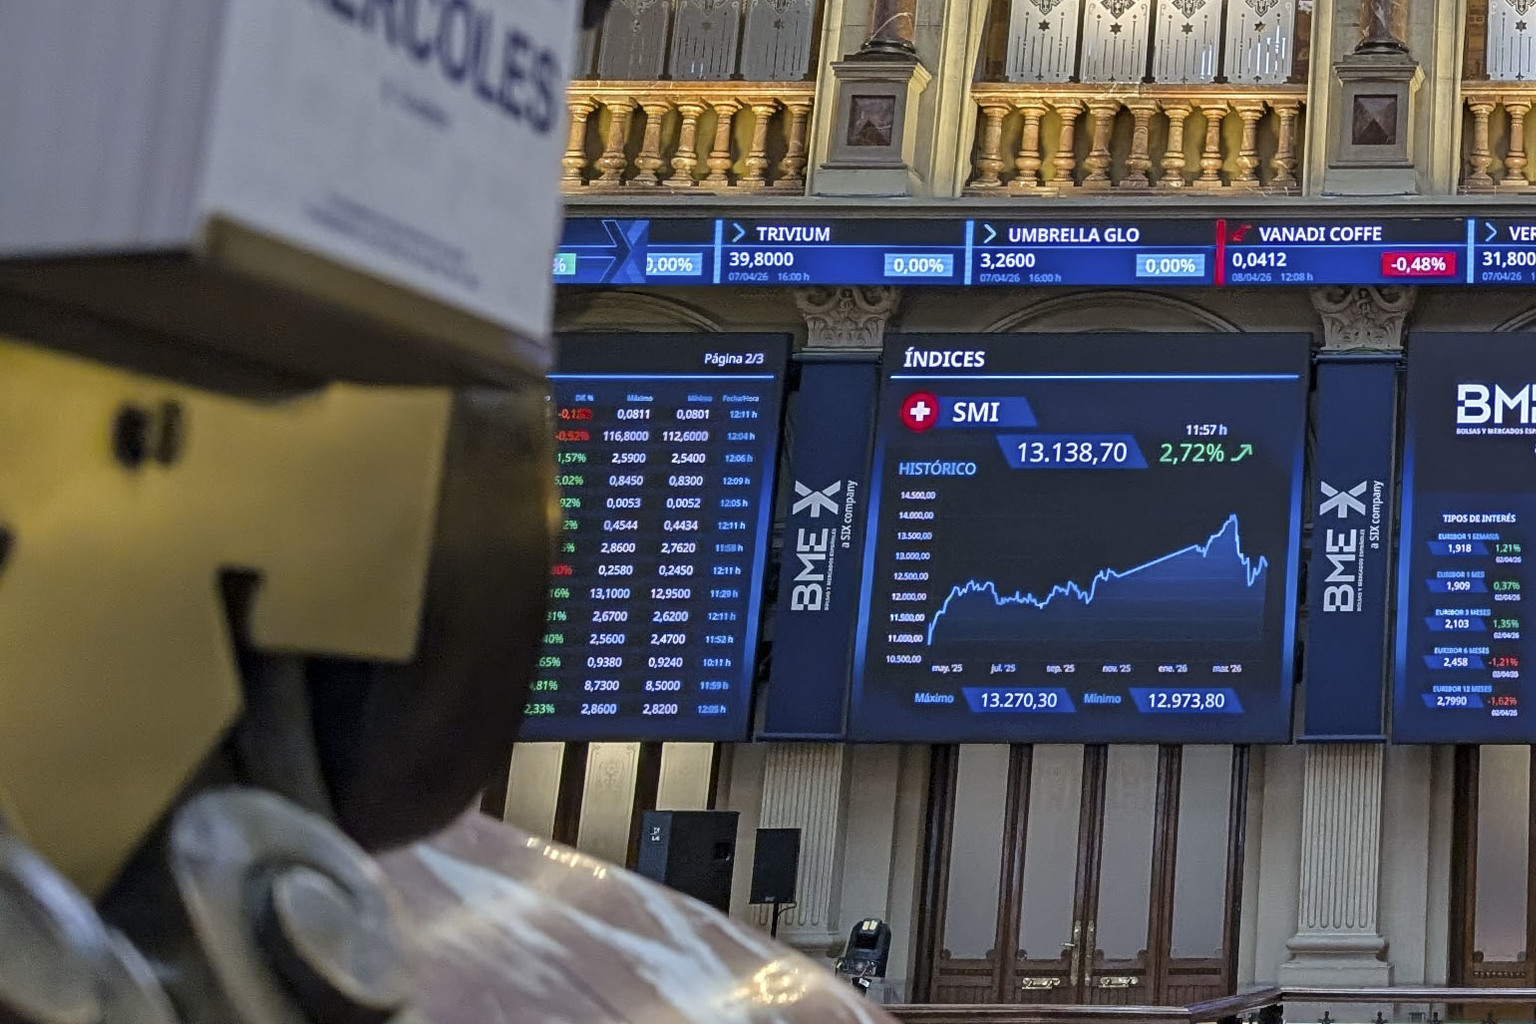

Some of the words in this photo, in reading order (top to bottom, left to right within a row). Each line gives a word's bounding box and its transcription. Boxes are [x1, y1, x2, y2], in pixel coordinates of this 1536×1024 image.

[756, 227, 830, 241] TRIVIUM
[1009, 228, 1100, 242] UMBRELLA
[1104, 228, 1140, 242] GLO
[1259, 227, 1325, 241] VANADI
[1330, 227, 1382, 241] COFFE
[729, 252, 794, 268] 39,8000
[894, 258, 944, 273] 0,00%
[980, 253, 1035, 268] 3,2600
[1146, 258, 1195, 274] 0,00%
[1232, 252, 1287, 268] 0,0412
[1391, 257, 1445, 272] -0,48%
[705, 354, 743, 366] Página
[745, 354, 763, 364] 2/3
[903, 347, 985, 368] ÍNDICES
[617, 409, 650, 420] 0,0811
[677, 409, 709, 420] 0,0801
[953, 402, 1000, 422] SMI
[1186, 425, 1217, 436] 11:57
[1219, 424, 1228, 436] h
[612, 453, 646, 464] 2,5900
[671, 453, 705, 464] 2,5400
[1017, 442, 1127, 465] 13.138,70
[1159, 444, 1224, 465] 2,72%
[899, 460, 977, 476] HISTÓRICO
[844, 480, 858, 523] company
[1372, 481, 1384, 523] company
[1443, 514, 1468, 522] TIPOS
[1469, 514, 1480, 522] DE
[1482, 513, 1516, 523] INTERÉS
[841, 525, 851, 540] SIX
[1370, 525, 1379, 541] SIX
[601, 543, 635, 554] 2,8600
[661, 543, 696, 554] 2,7620
[1448, 544, 1472, 554] 1,918
[791, 528, 828, 610] BME
[1323, 529, 1356, 612] BME
[591, 588, 630, 600] 13,1000
[651, 589, 690, 600] 12,9500
[1445, 619, 1469, 629] 2,103
[1443, 658, 1468, 668] 2,458
[915, 692, 954, 704] Máximo
[981, 693, 1057, 710] 13.270,30
[1084, 693, 1121, 704] Mínimo
[1148, 693, 1224, 710] 12.973,80
[1437, 697, 1467, 707] 2,7990
[581, 704, 616, 715] 2,8600
[643, 704, 677, 715] 2,8200
